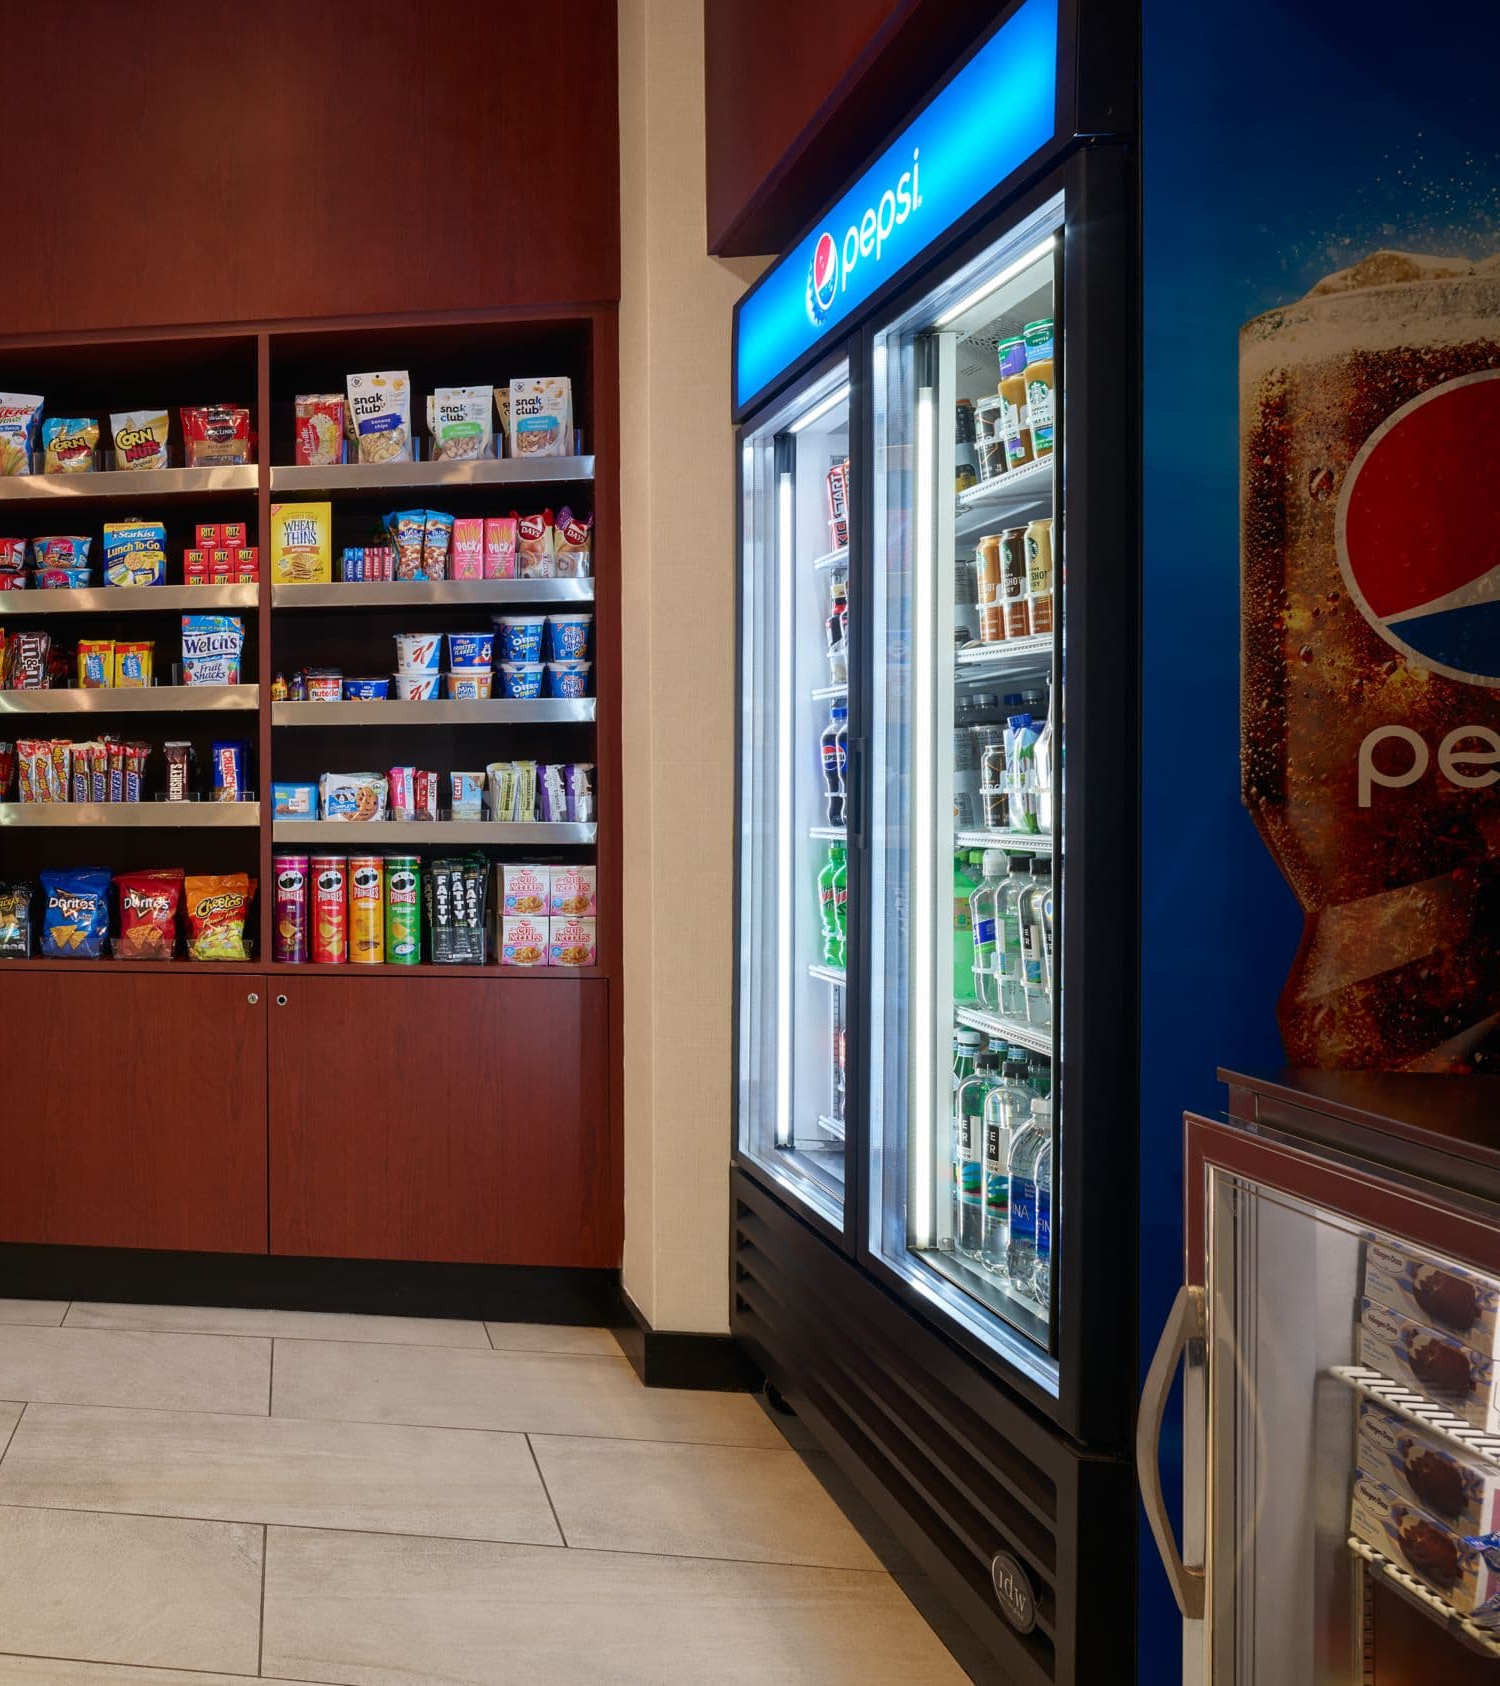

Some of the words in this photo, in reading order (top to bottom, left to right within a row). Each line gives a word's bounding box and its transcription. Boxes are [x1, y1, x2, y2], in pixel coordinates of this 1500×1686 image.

[841, 147, 923, 292] pepsi
[354, 392, 384, 405] snak
[515, 396, 542, 407] snak
[355, 404, 381, 415] club
[440, 404, 467, 413] snak
[515, 406, 540, 415] club
[440, 413, 465, 422] club
[225, 527, 241, 537] RITZ
[284, 519, 317, 532] WHEAT
[521, 526, 541, 538] DAYS
[118, 530, 156, 539] StarKist
[200, 527, 216, 538] RITZ
[284, 530, 317, 546] THINS
[566, 530, 586, 543] DAYS
[107, 542, 133, 559] Lunch
[189, 552, 204, 562] RITZ
[214, 551, 229, 561] RITZ
[238, 550, 254, 560] RITZ
[183, 634, 238, 654] Welch's
[311, 687, 339, 697] nutella
[278, 889, 304, 902] PRINGLES
[317, 890, 343, 903] PRINGLES
[354, 886, 380, 899] PRINGLES
[390, 891, 416, 904] PRINGLES
[452, 871, 465, 920] FATTY
[48, 897, 97, 911] Doritos
[123, 897, 171, 910] Doritos
[195, 893, 244, 919] Cheetos
[436, 874, 449, 926] FATTY
[465, 879, 478, 928] FATTY
